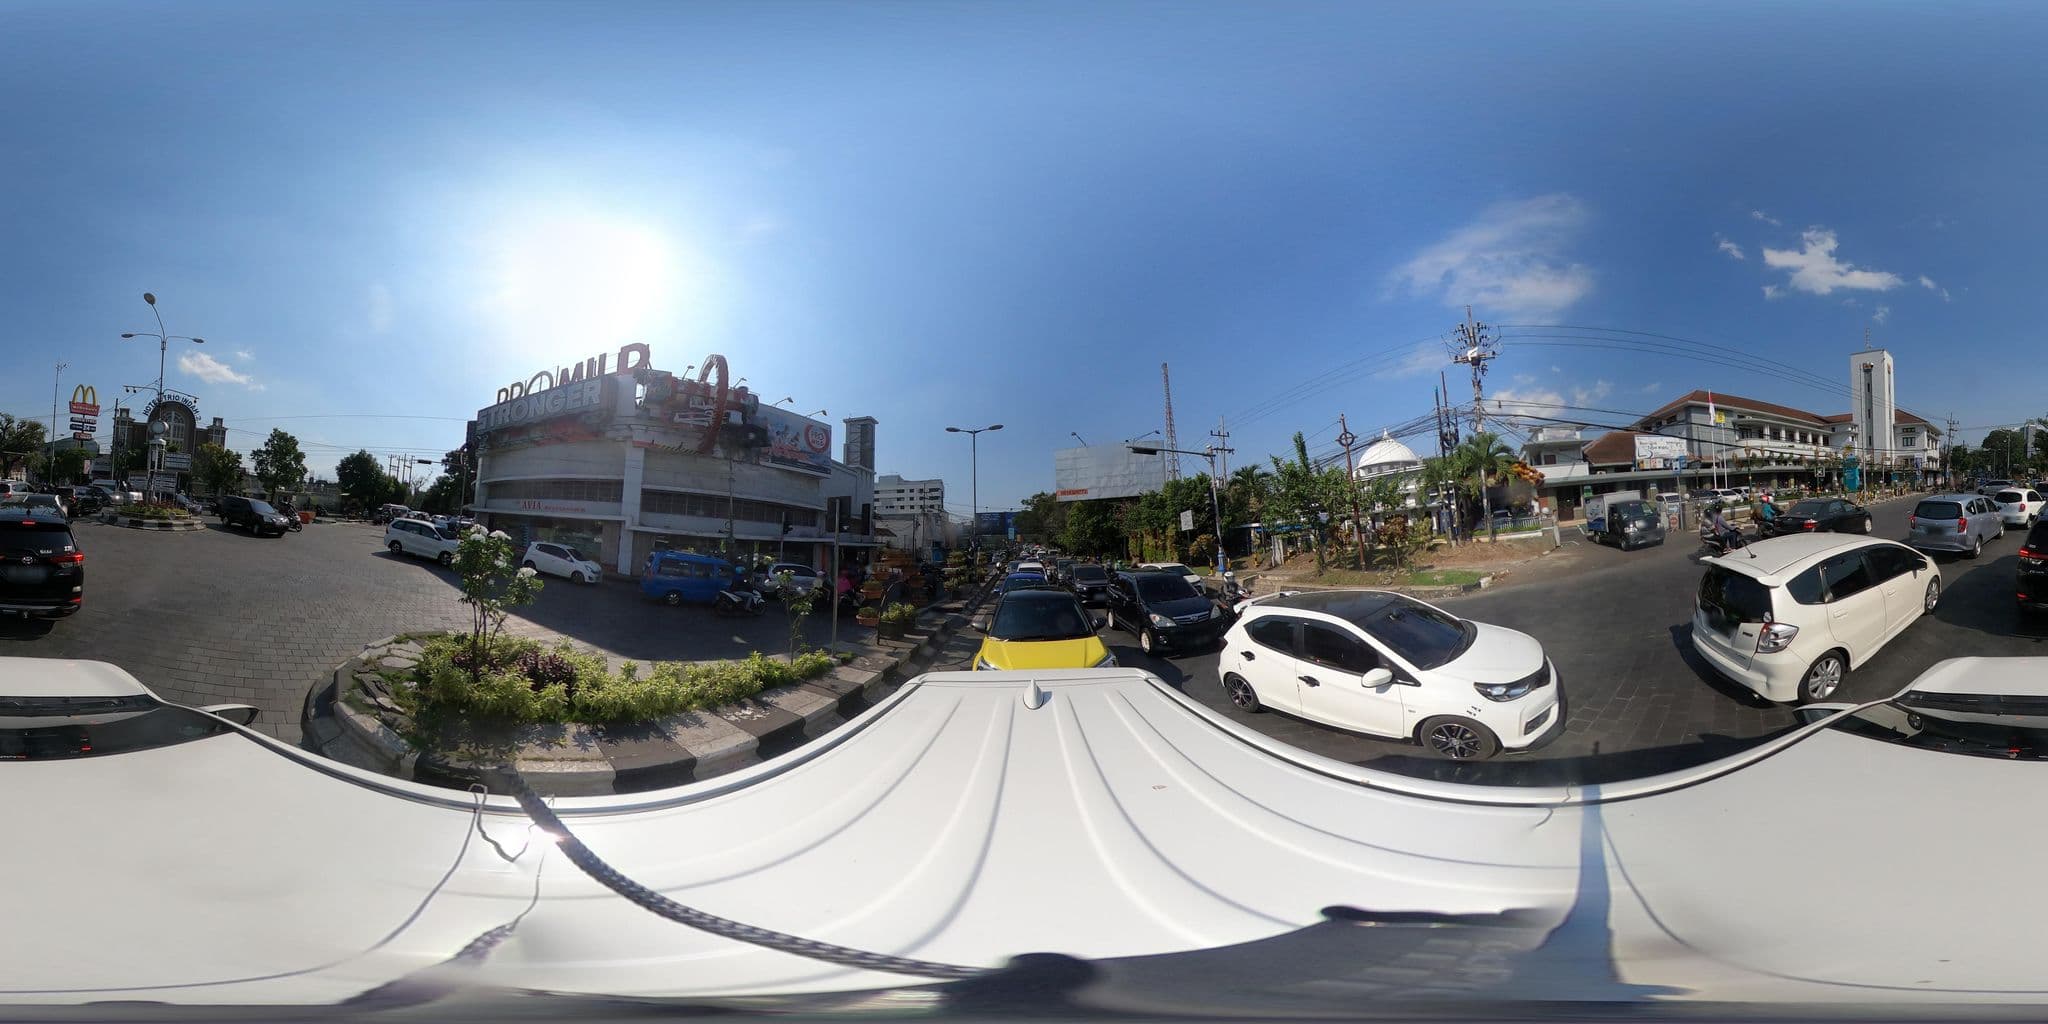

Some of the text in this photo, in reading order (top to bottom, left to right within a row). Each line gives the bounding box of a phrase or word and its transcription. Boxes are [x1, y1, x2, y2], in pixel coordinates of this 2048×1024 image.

[181, 396, 200, 415] INDAH
[477, 379, 601, 431] STRONGER
[521, 500, 543, 511] AVIA
